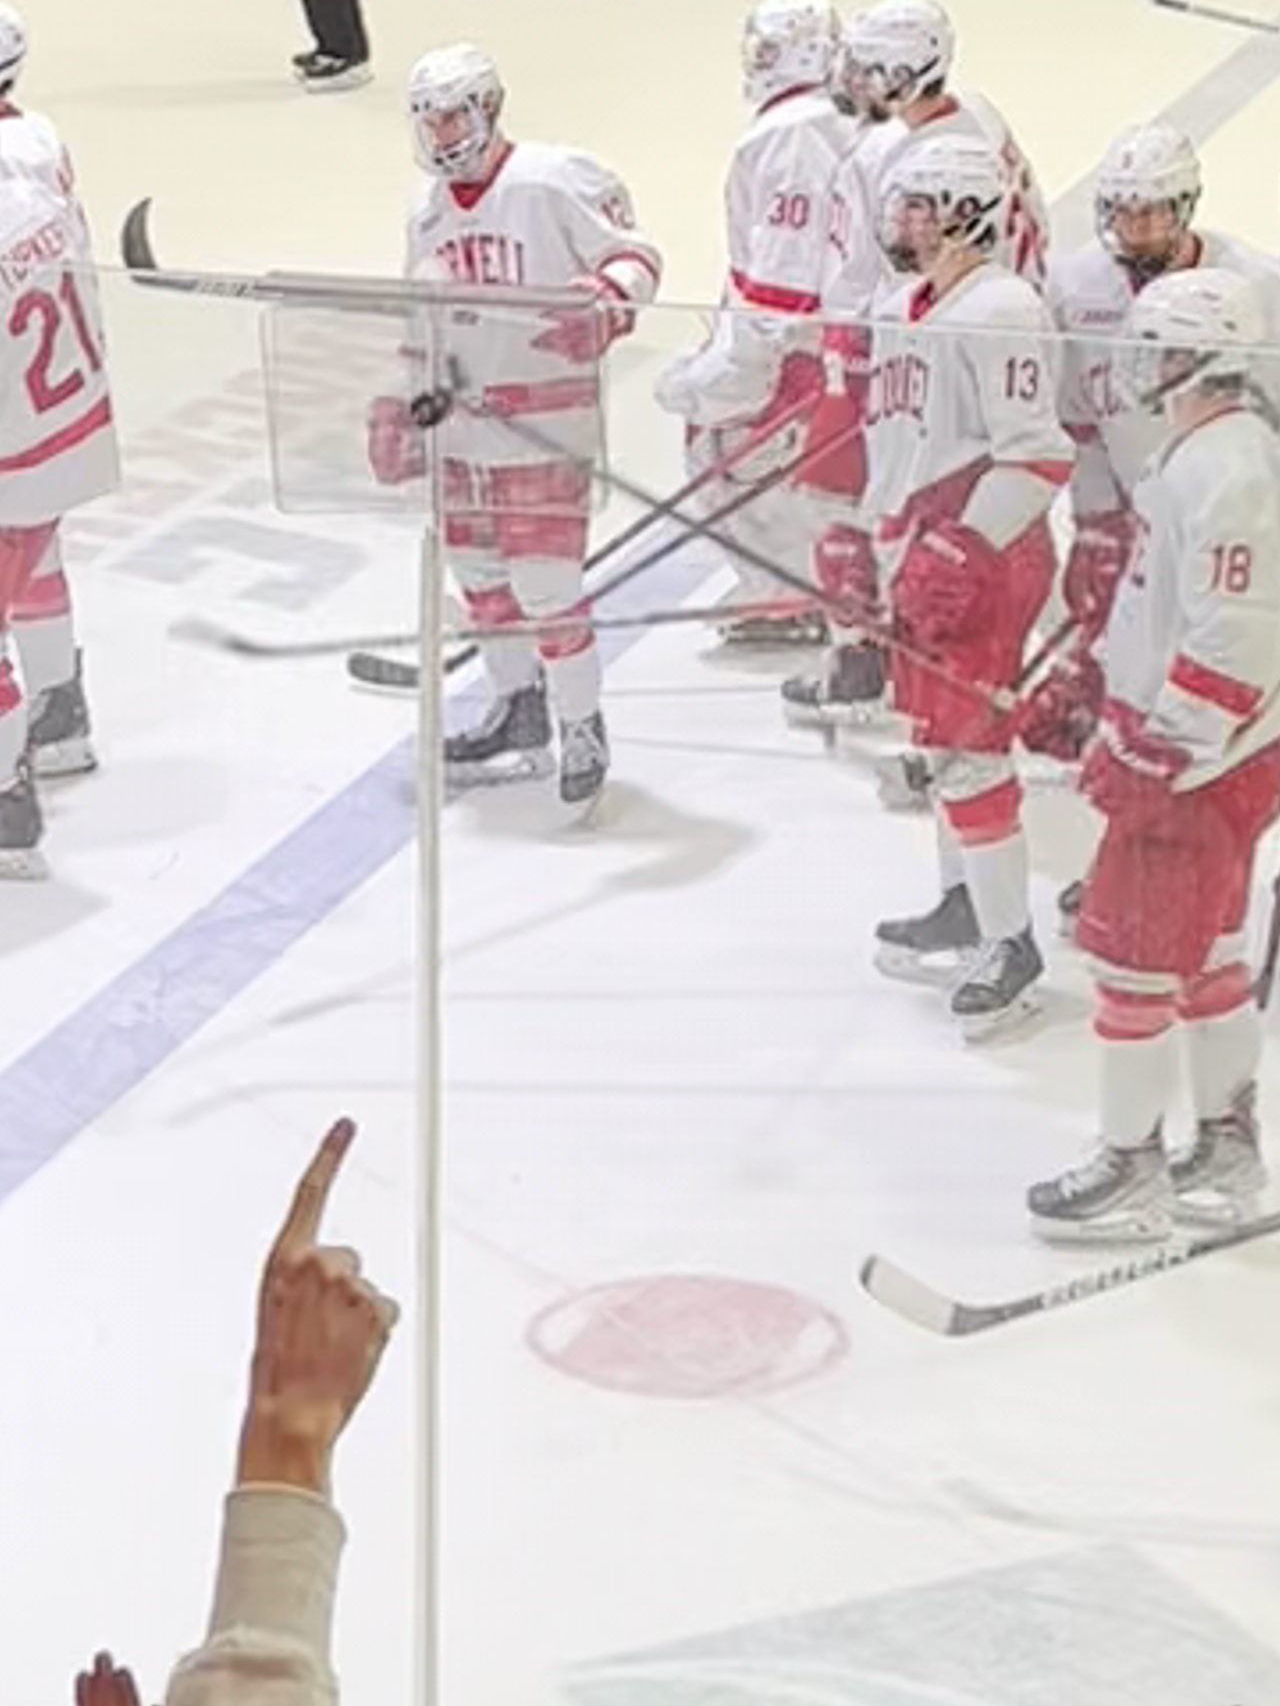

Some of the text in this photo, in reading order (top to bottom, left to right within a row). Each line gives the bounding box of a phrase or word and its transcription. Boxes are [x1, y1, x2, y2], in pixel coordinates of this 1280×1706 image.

[768, 192, 810, 230] 30
[8, 270, 102, 414] 21
[1004, 356, 1040, 402] 13
[1209, 542, 1253, 594] 18
